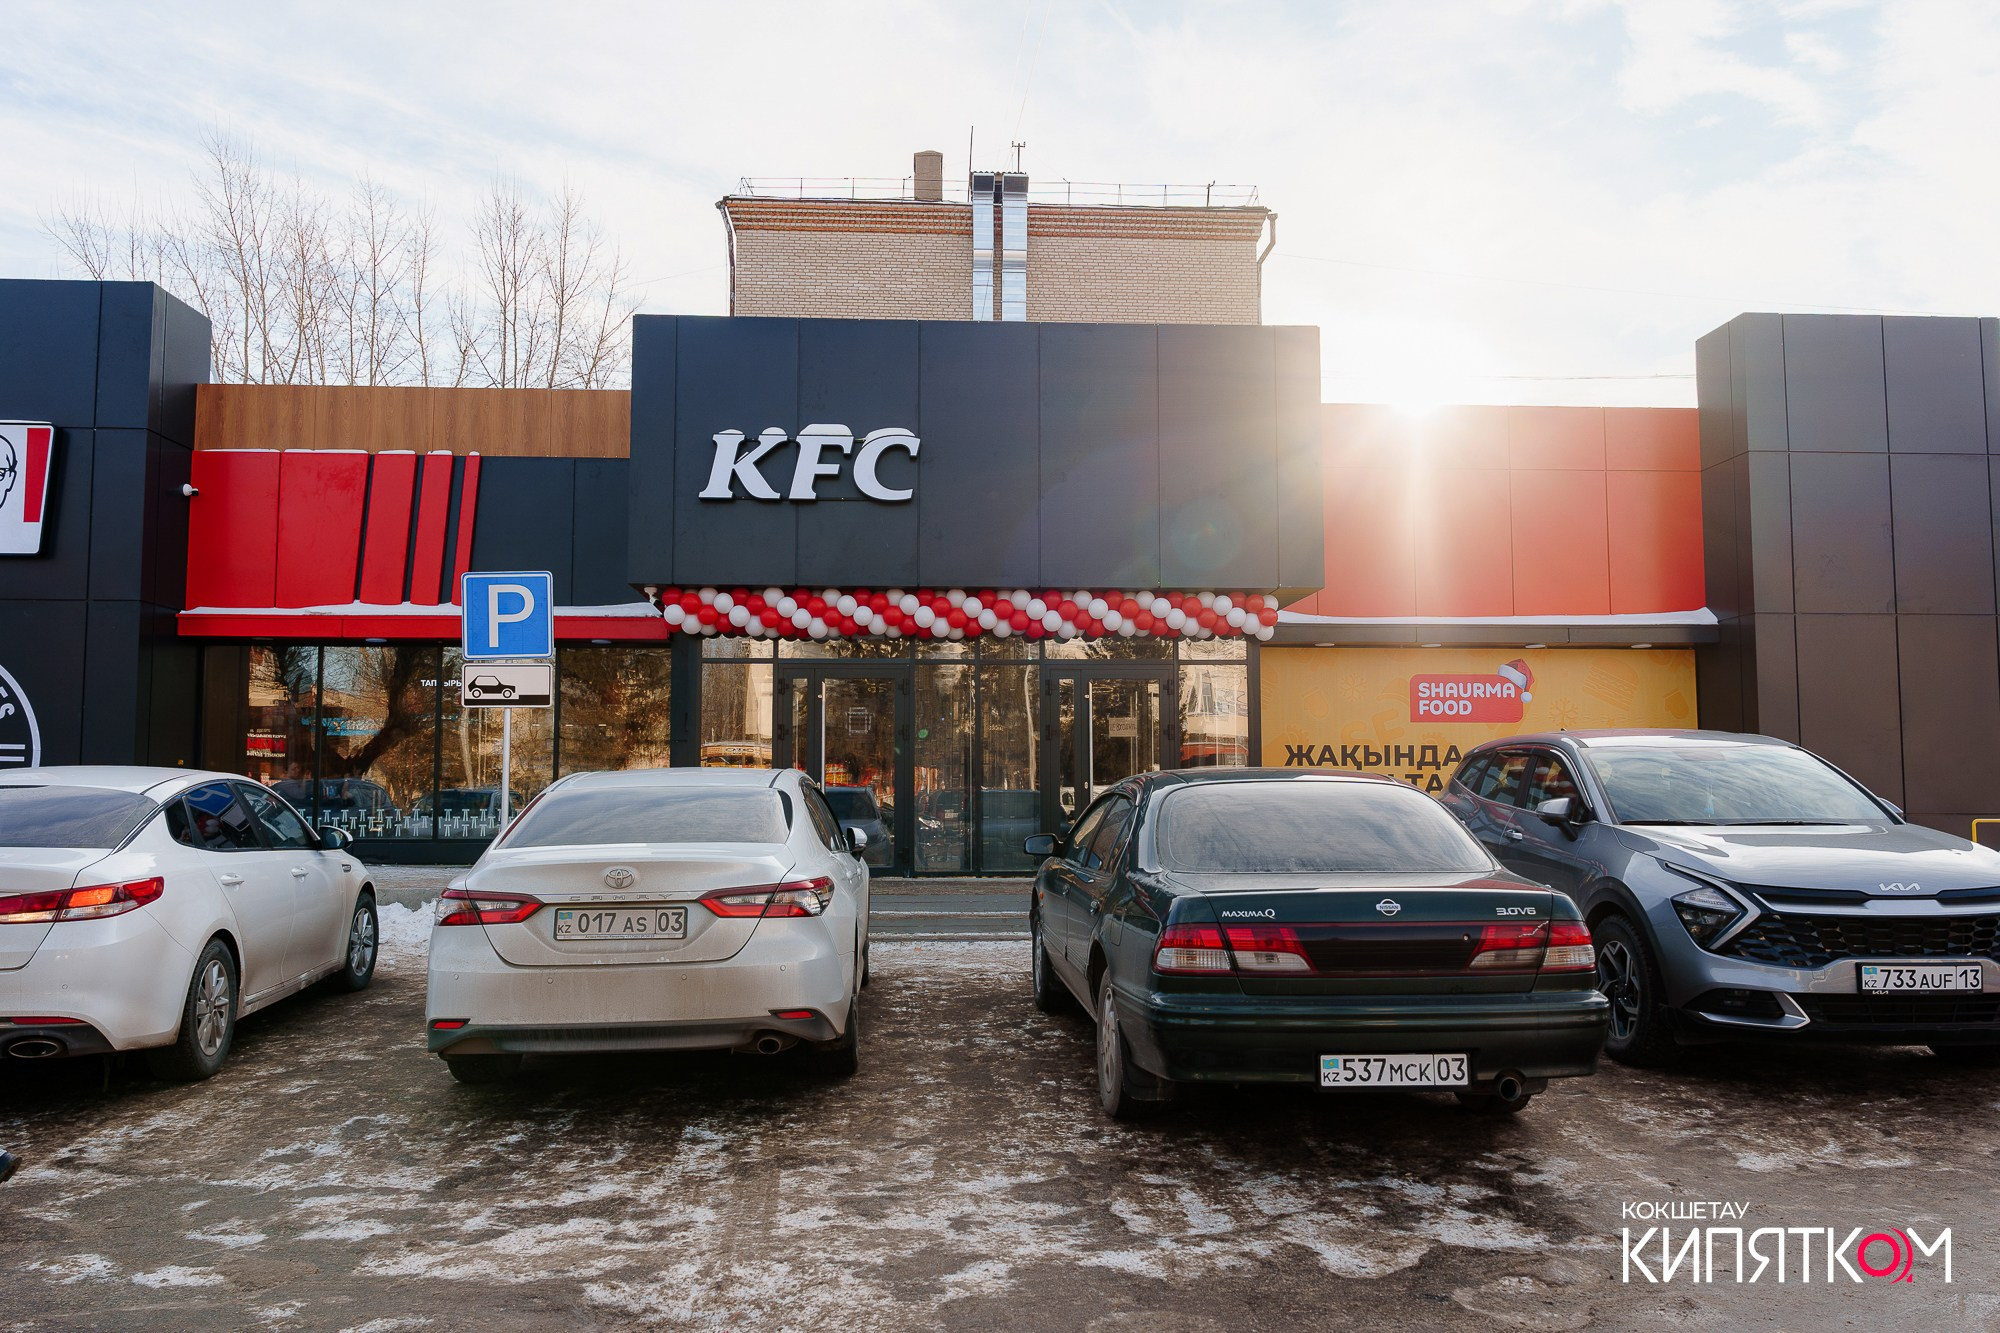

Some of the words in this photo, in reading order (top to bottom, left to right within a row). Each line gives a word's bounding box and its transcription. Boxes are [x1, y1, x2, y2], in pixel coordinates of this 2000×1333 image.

[698, 433, 921, 501] KFC
[488, 584, 535, 648] P
[1418, 682, 1516, 698] SHAURMA
[1418, 700, 1472, 715] FOOD
[1284, 744, 1462, 771] ЖАҚЫНДА
[569, 893, 673, 902] CAMRY
[557, 924, 572, 934] KZ
[577, 912, 617, 933] 017
[622, 916, 648, 933] AS
[657, 911, 684, 933] 03
[1864, 979, 1878, 988] KZ
[1959, 969, 1980, 988] 13
[1322, 1072, 1340, 1083] KZ
[1437, 1057, 1466, 1082] 03
